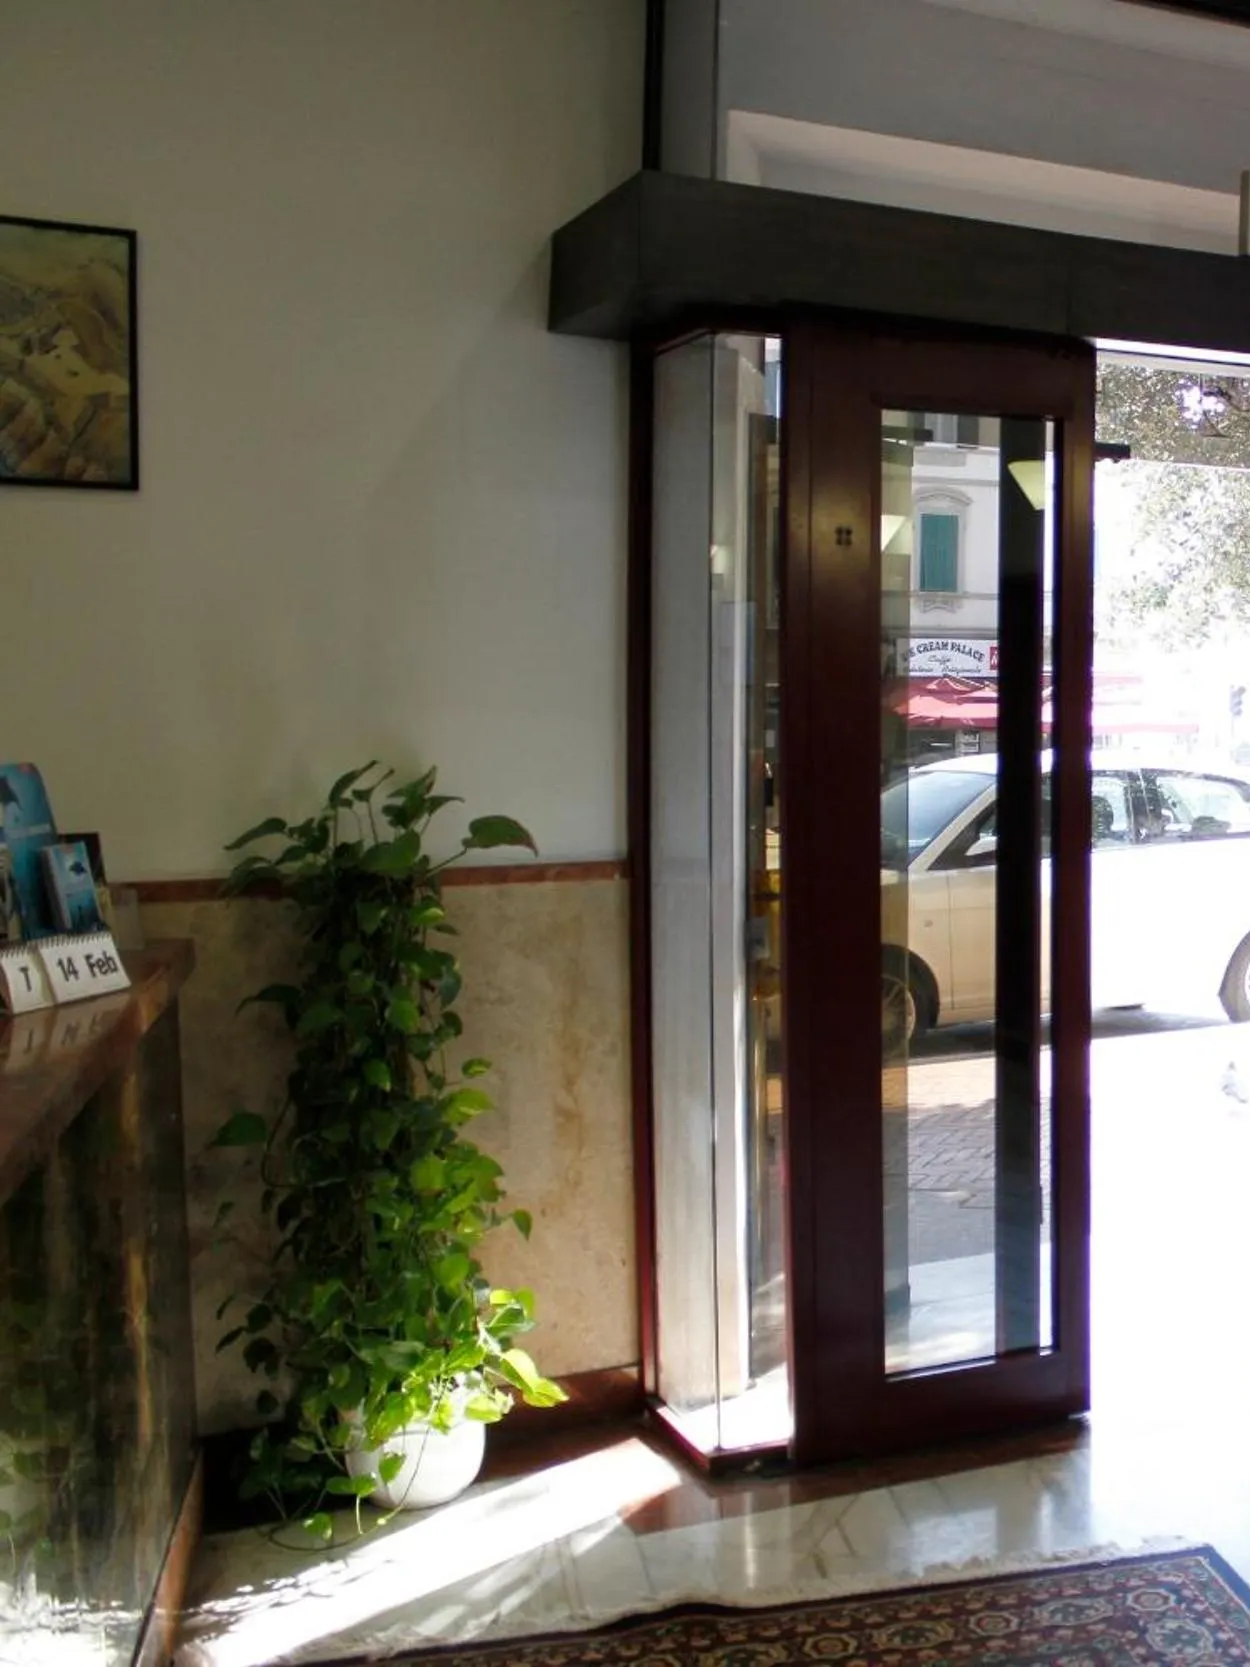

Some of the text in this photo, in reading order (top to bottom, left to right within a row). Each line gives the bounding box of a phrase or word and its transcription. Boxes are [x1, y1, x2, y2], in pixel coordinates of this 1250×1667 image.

[917, 641, 949, 654] CREAM
[950, 642, 985, 662] PALACE
[57, 957, 80, 982] 14
[84, 951, 118, 978] Feb
